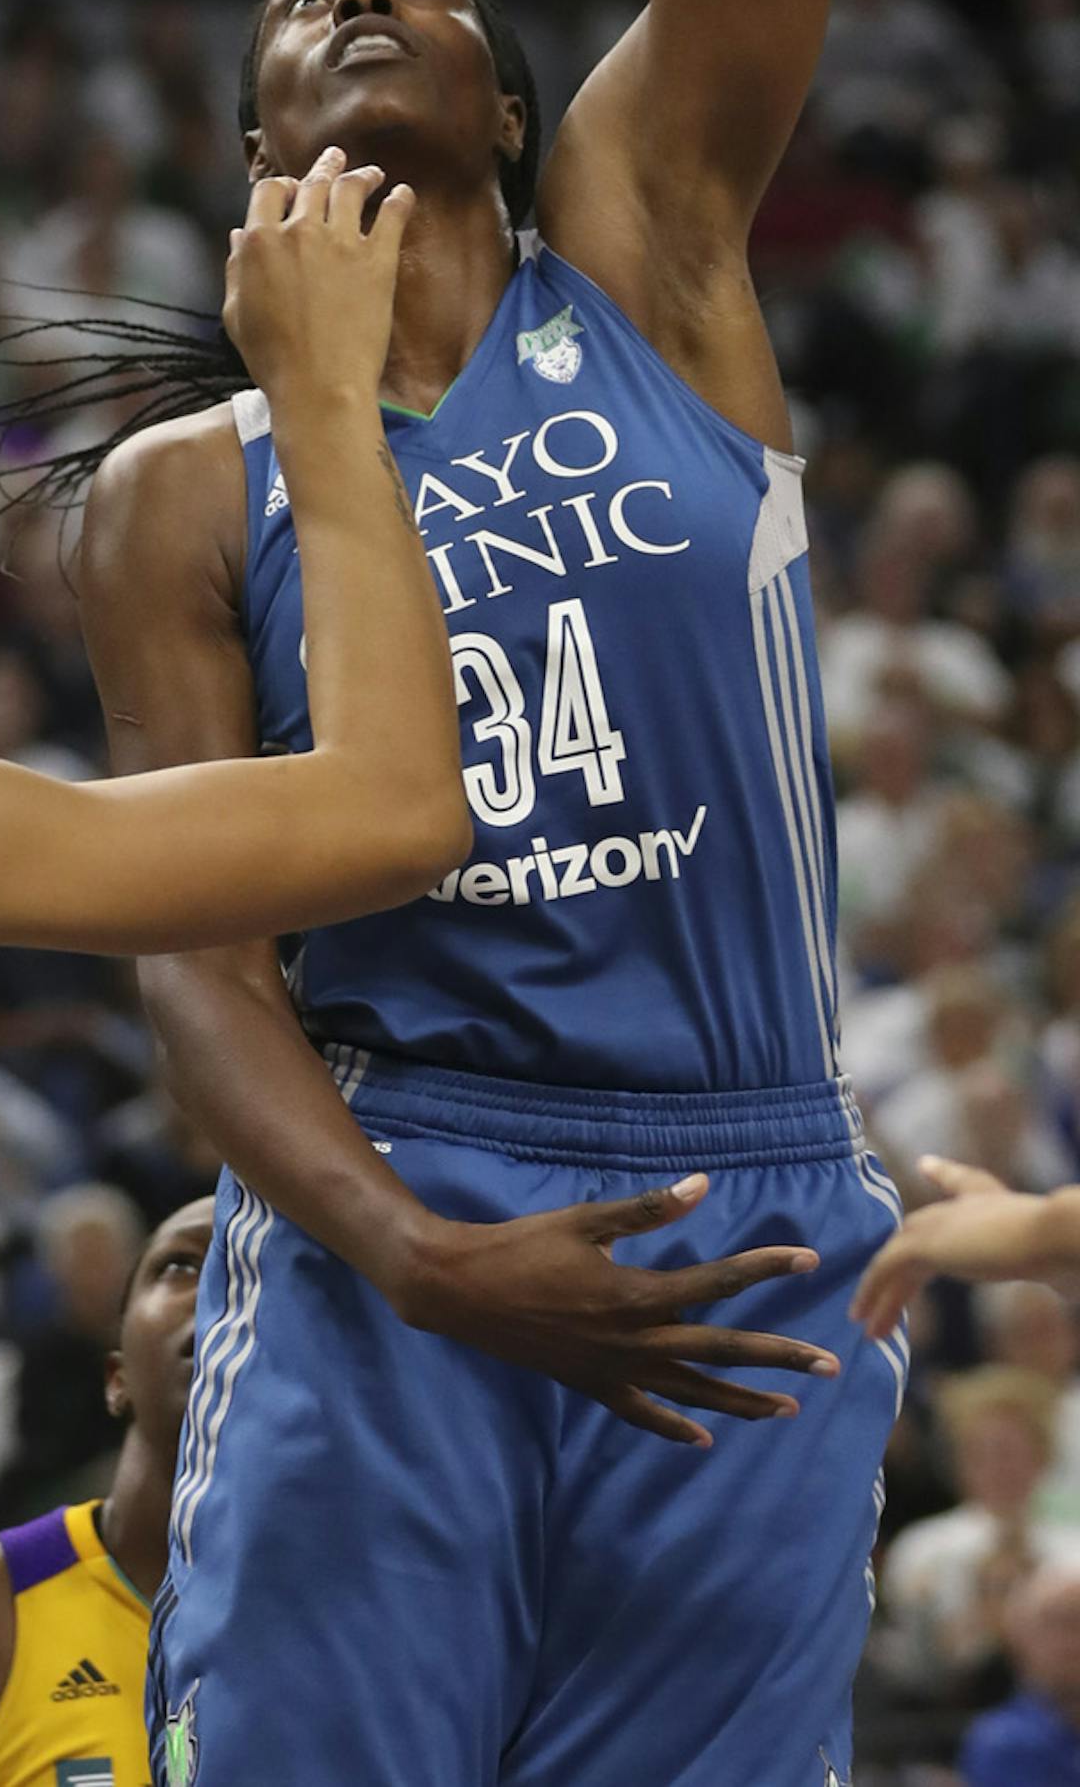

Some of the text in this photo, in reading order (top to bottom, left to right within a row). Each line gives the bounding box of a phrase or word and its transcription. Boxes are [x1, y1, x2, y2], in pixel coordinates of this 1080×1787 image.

[414, 410, 619, 536] AYO
[426, 479, 691, 615] INIC
[448, 597, 627, 828] 34
